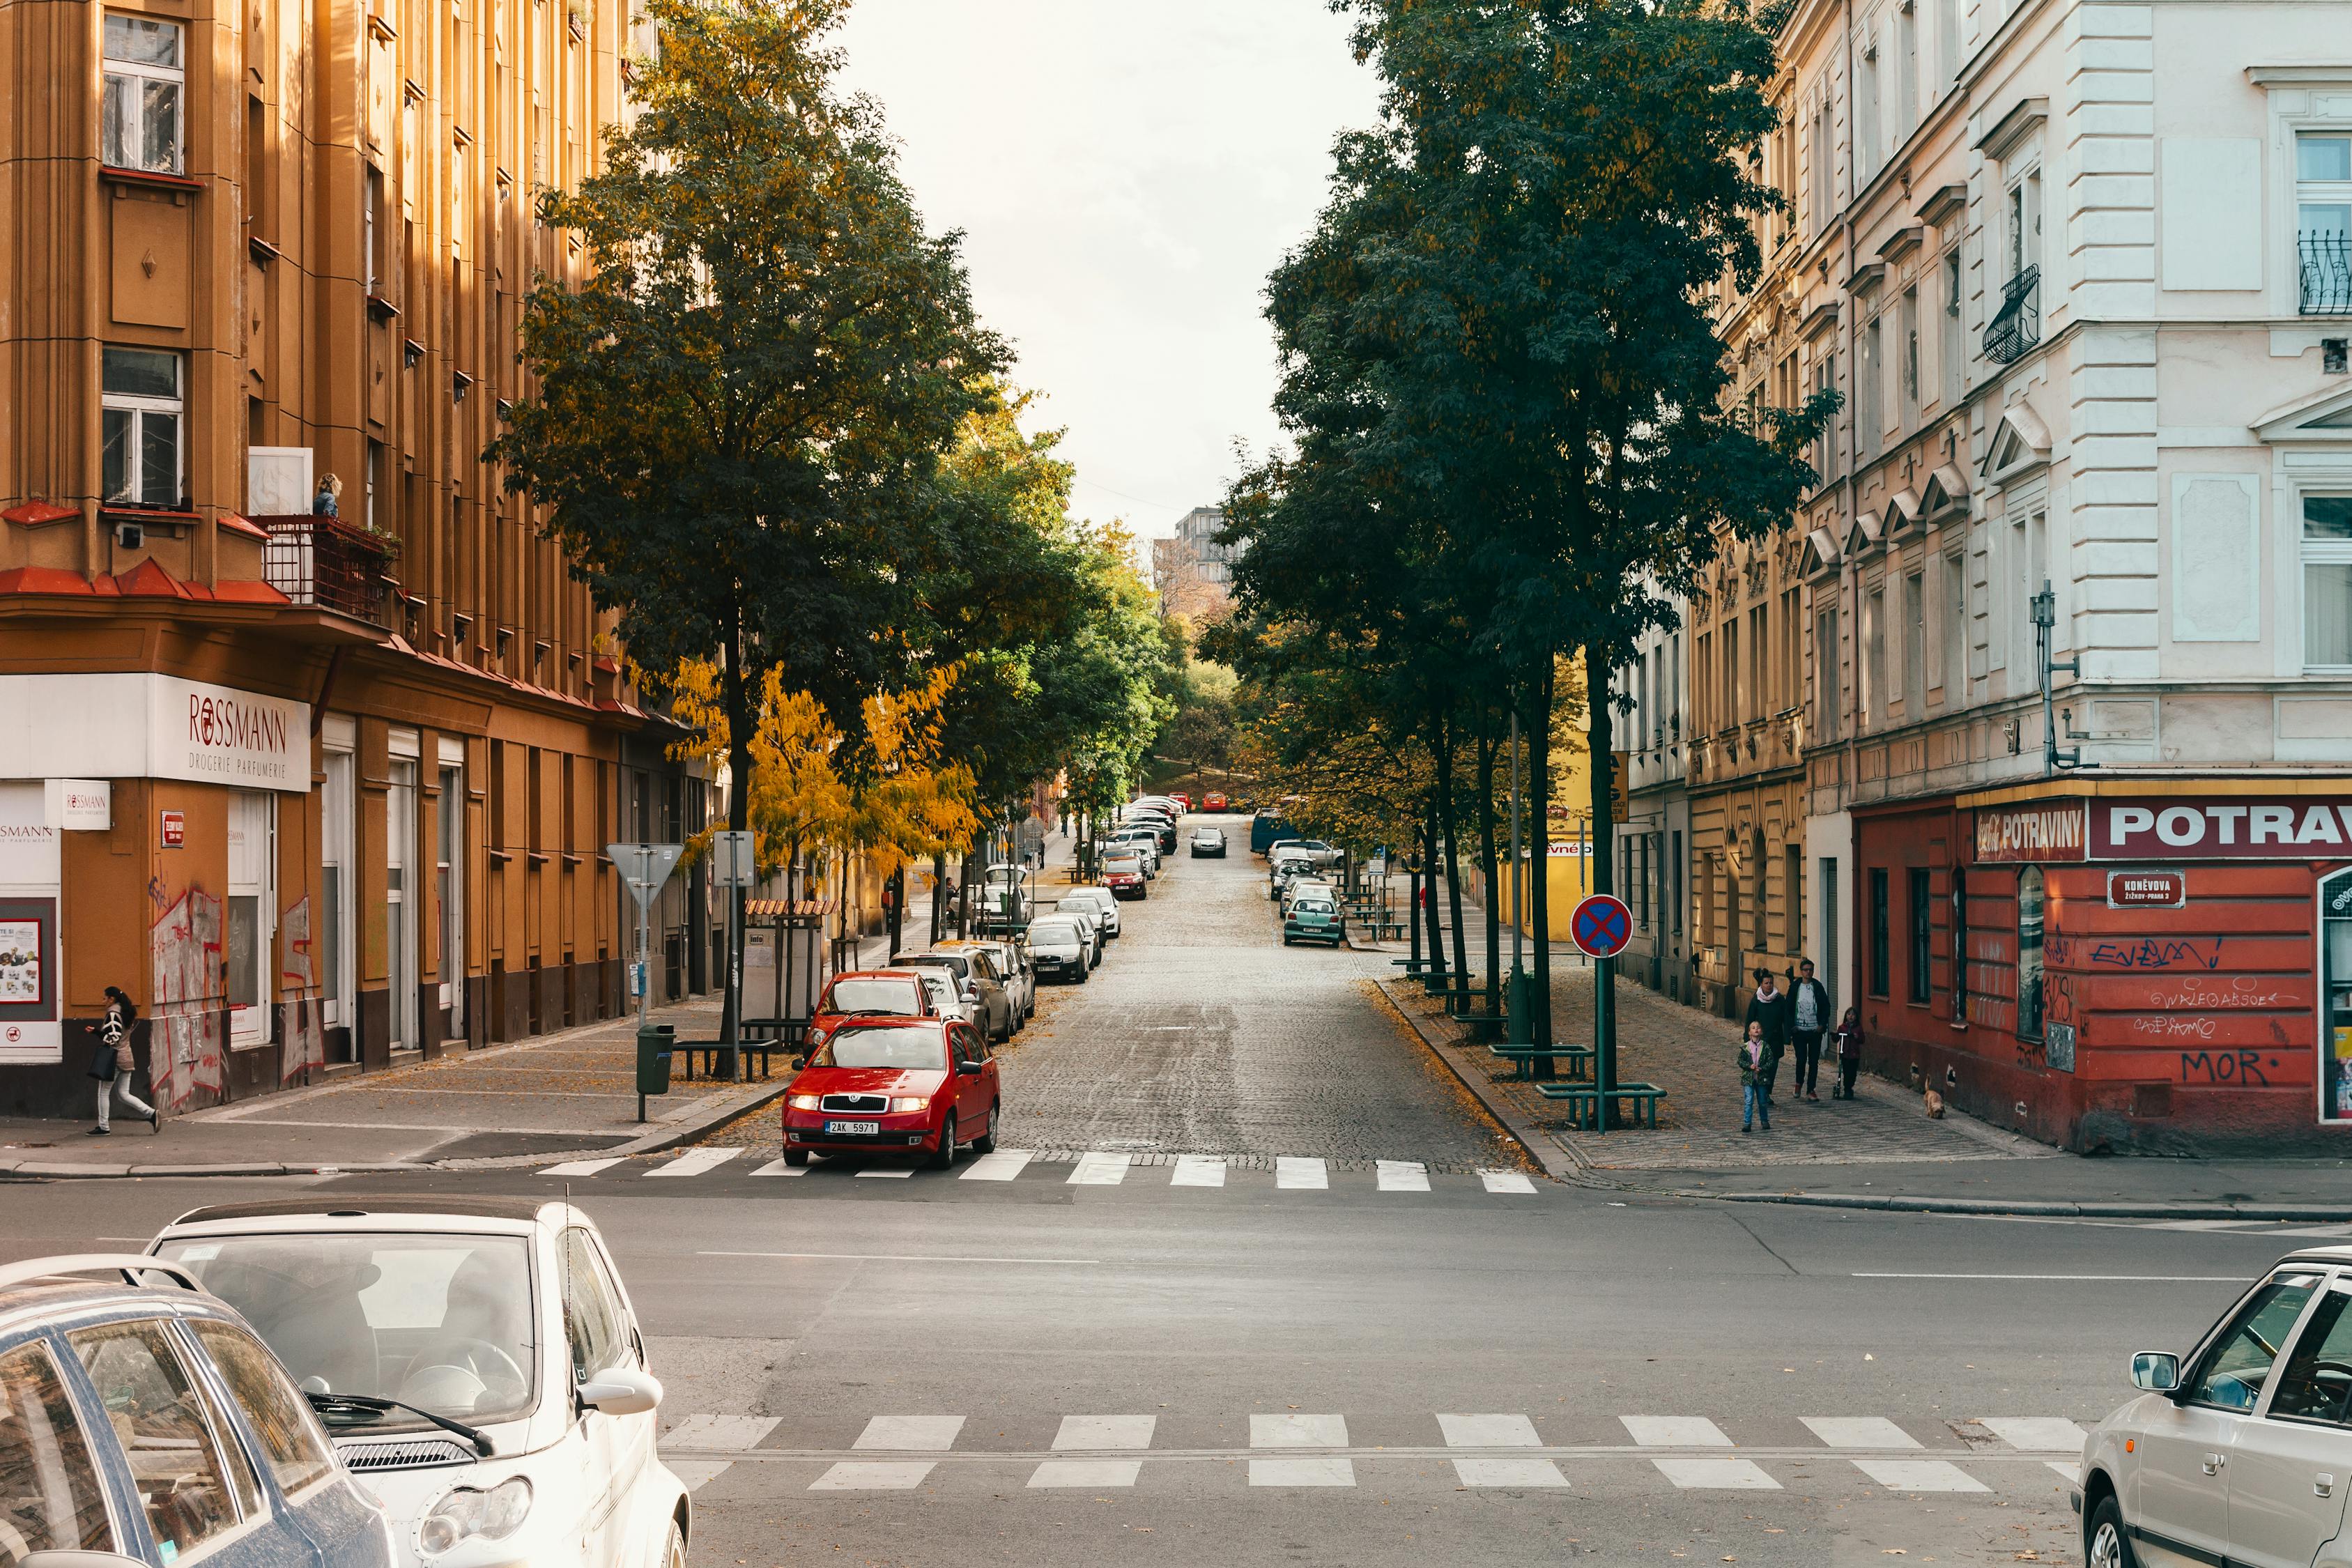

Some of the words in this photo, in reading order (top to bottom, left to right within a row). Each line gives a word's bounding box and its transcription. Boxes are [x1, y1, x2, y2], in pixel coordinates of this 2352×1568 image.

[190, 694, 286, 754] ROSSMANN
[190, 752, 230, 772] DROGERIE
[237, 759, 285, 779] PARFUMERIE
[67, 794, 105, 808] ROSSMANN
[2003, 810, 2082, 850] POTRAVINY
[2124, 879, 2171, 891] KONĚVOVA
[832, 1123, 847, 1132] 2AK
[853, 1124, 874, 1132] 5971
